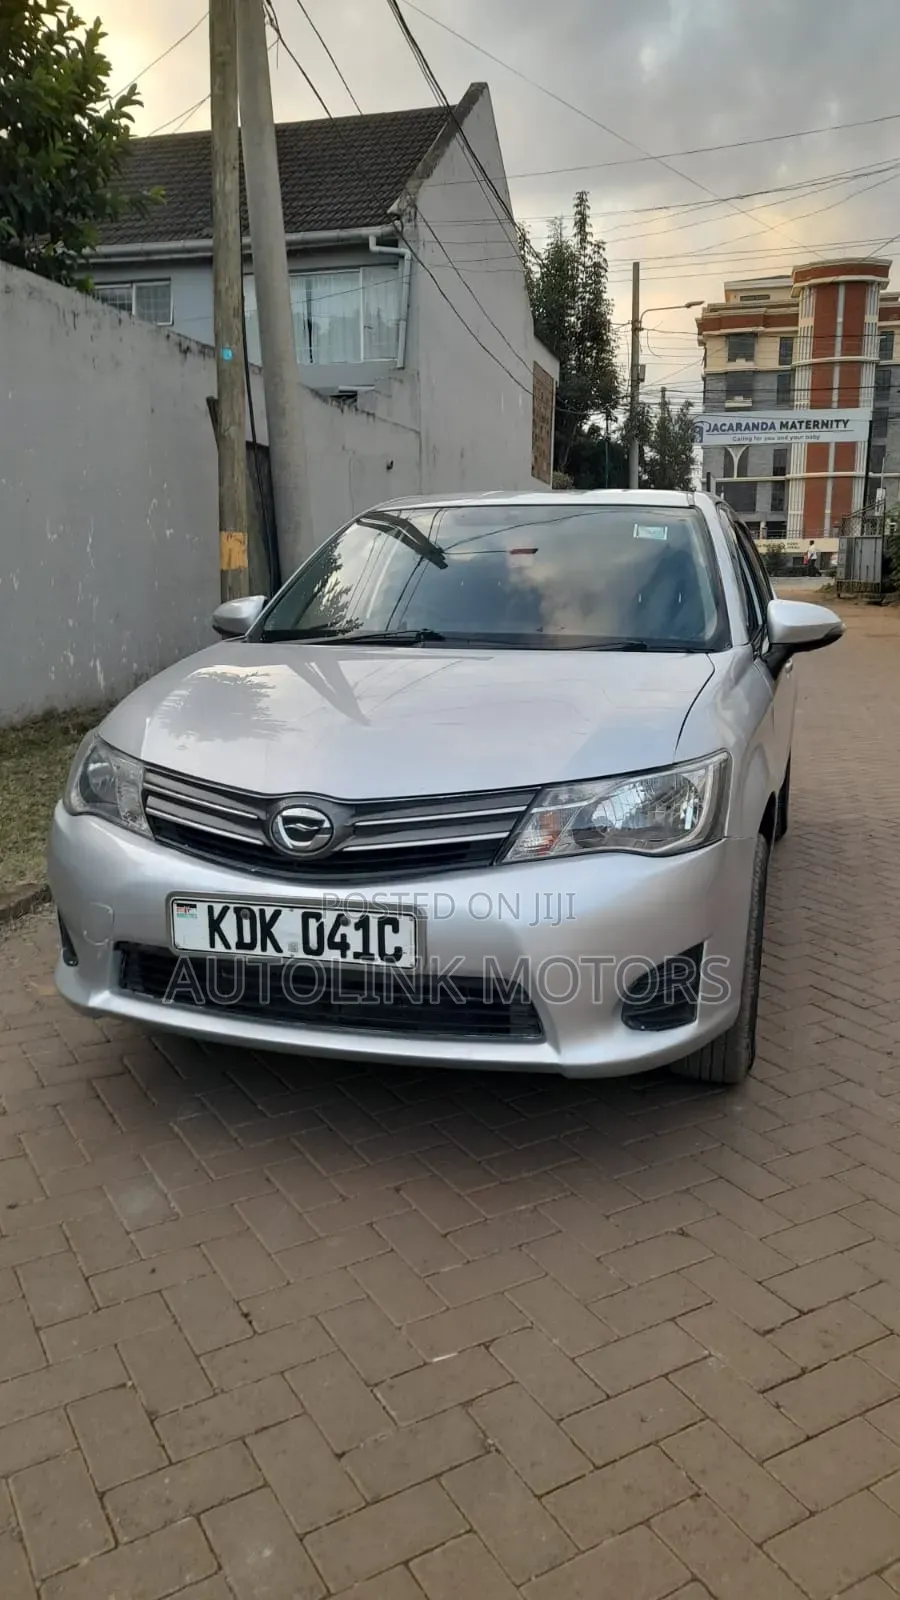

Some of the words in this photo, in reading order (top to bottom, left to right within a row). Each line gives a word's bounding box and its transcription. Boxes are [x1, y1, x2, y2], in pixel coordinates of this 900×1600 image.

[706, 420, 776, 432] JACARANDA
[779, 419, 850, 431] MATERNITY
[789, 434, 803, 442] your
[207, 904, 283, 954] KDK
[301, 911, 403, 962] 041C
